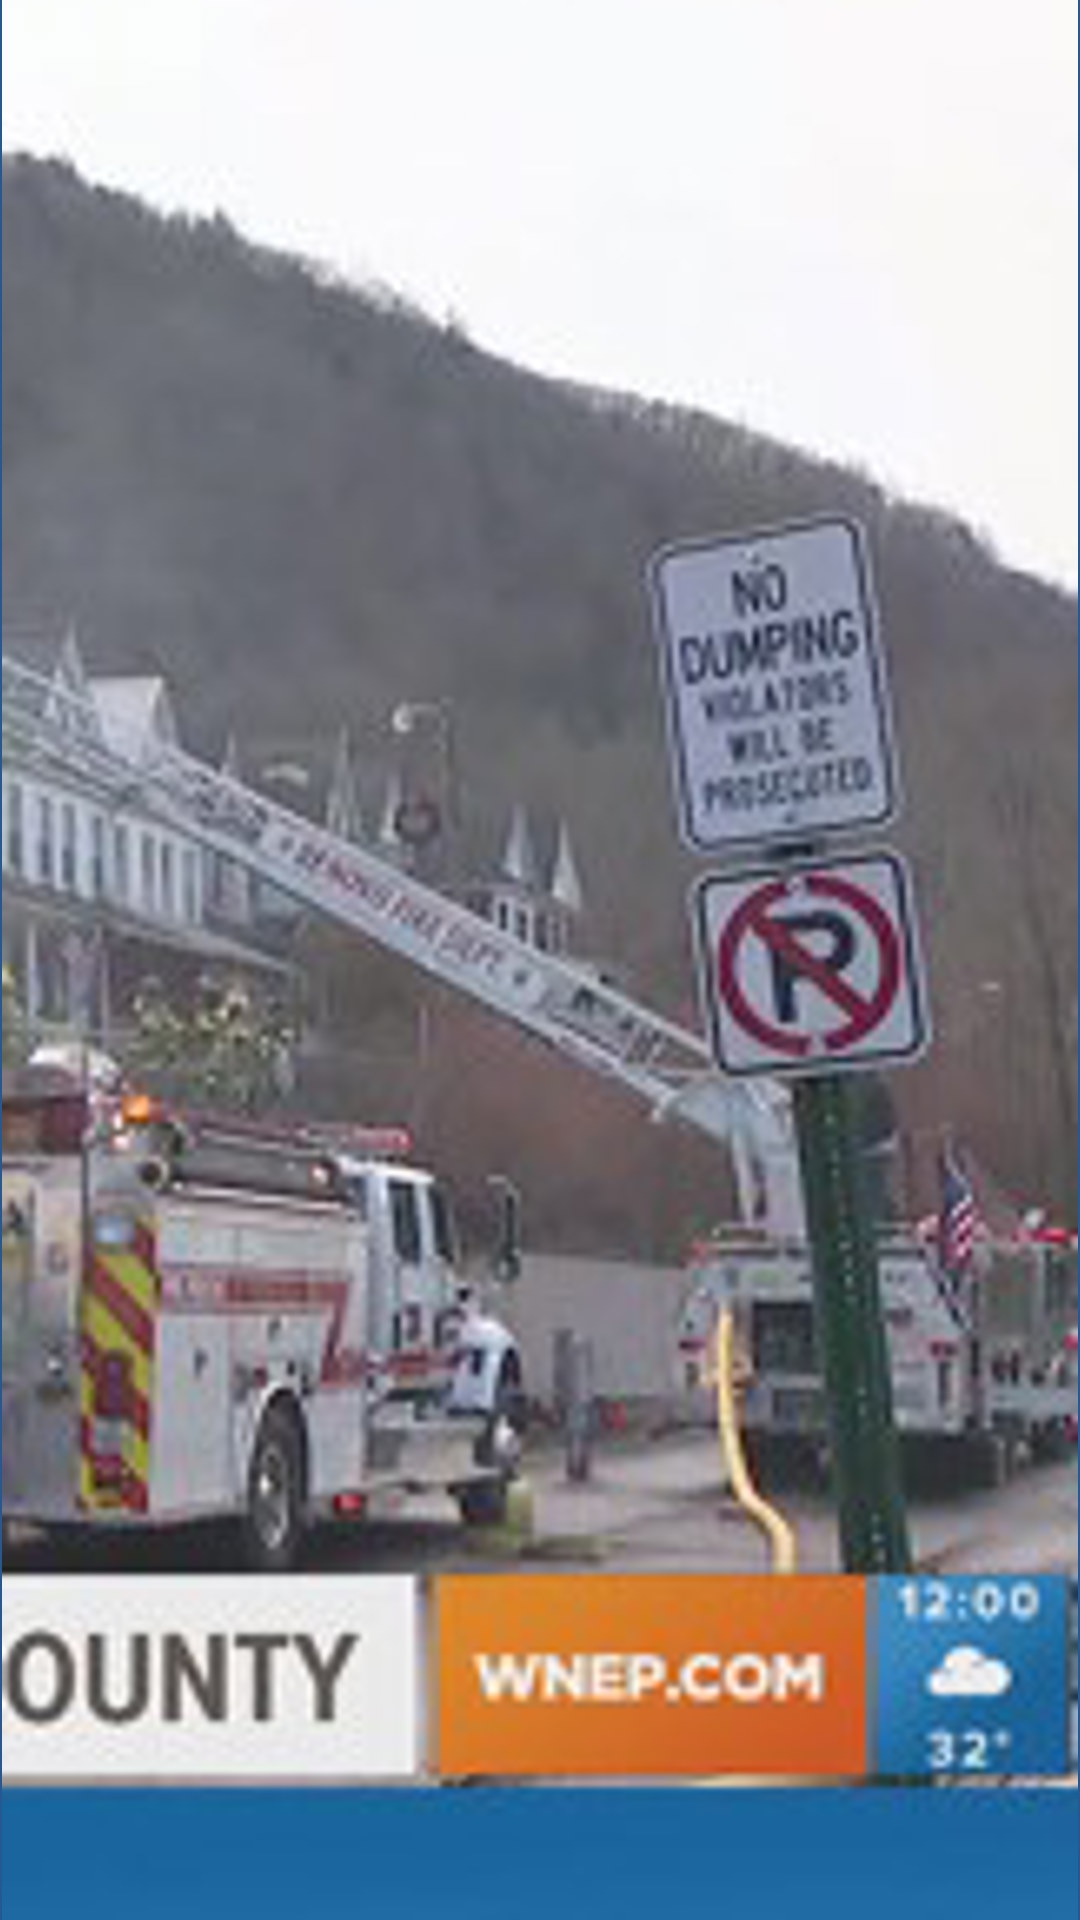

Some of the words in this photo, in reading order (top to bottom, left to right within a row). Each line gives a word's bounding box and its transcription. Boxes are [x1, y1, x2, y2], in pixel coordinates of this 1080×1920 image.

[730, 563, 787, 616] NO
[680, 609, 859, 686] DUMPING
[701, 668, 850, 721] VIOLATORS
[728, 726, 788, 764] WILL
[800, 716, 835, 753] BE
[703, 756, 872, 812] PROSECUTED
